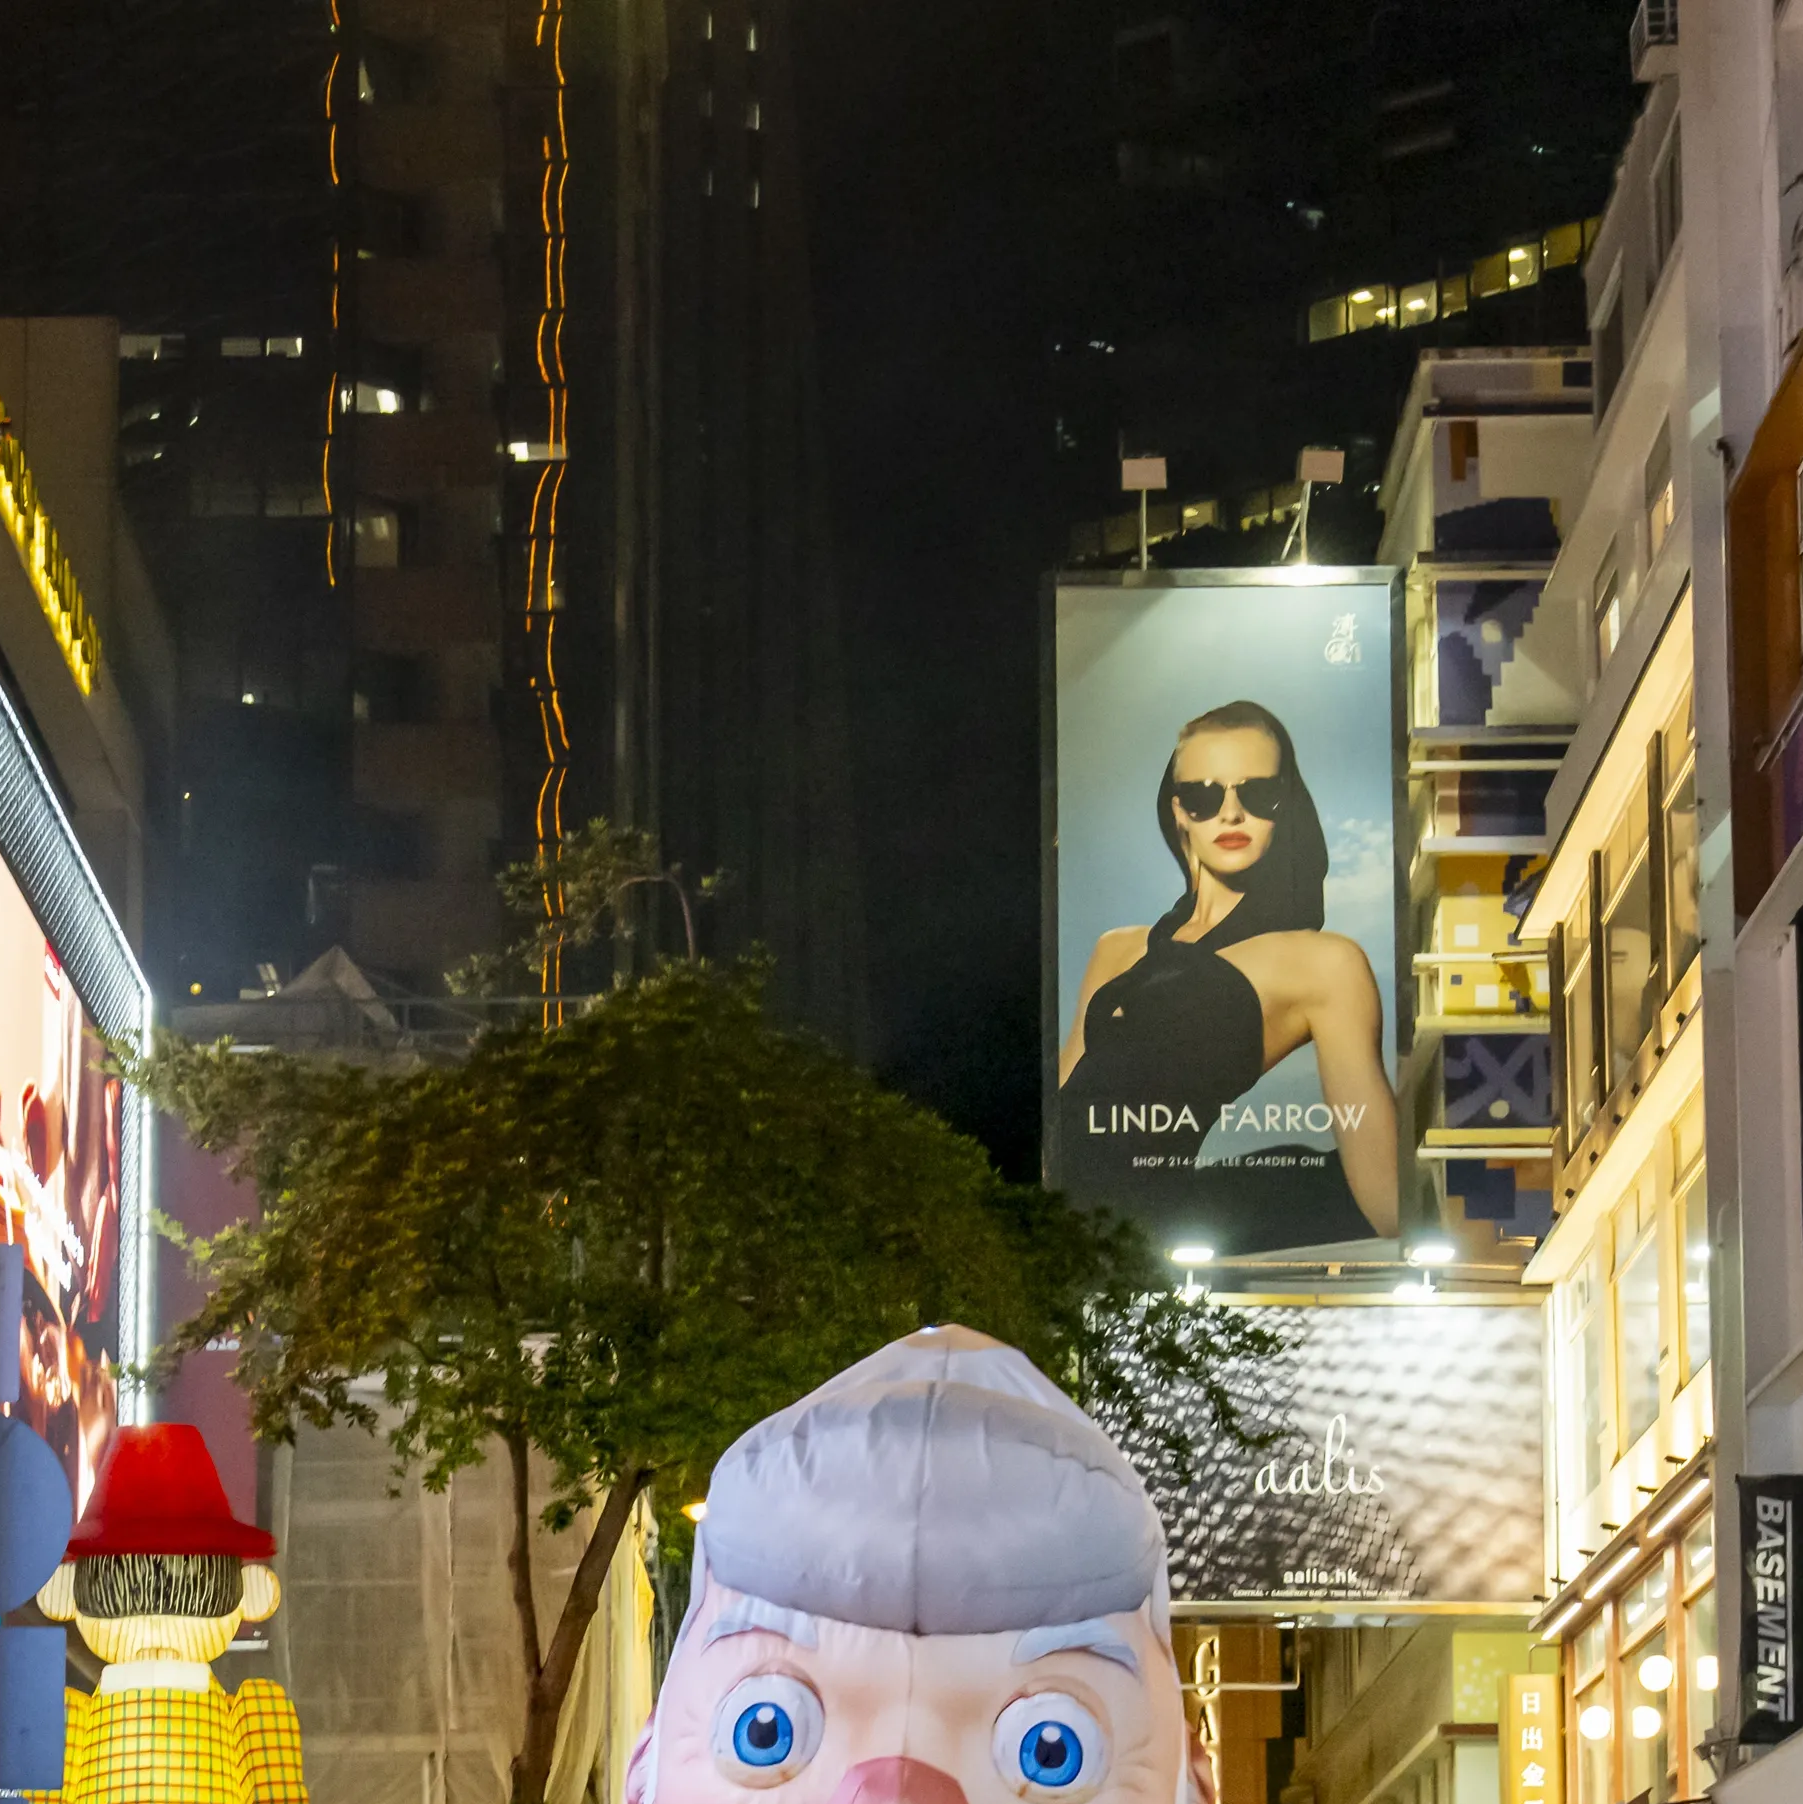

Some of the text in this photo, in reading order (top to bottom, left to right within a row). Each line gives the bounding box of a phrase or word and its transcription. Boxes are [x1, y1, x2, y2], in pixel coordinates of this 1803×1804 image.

[1088, 1103, 1368, 1135] LINDA FARROW
[1132, 1156, 1164, 1168] SHOP
[1221, 1156, 1242, 1168] LEE
[1245, 1156, 1296, 1168] GARDEN
[1300, 1156, 1326, 1168] ONE
[1254, 1412, 1386, 1496] aalis
[1283, 1567, 1360, 1586] aalis.hk
[1756, 1493, 1787, 1723] BASEMENT
